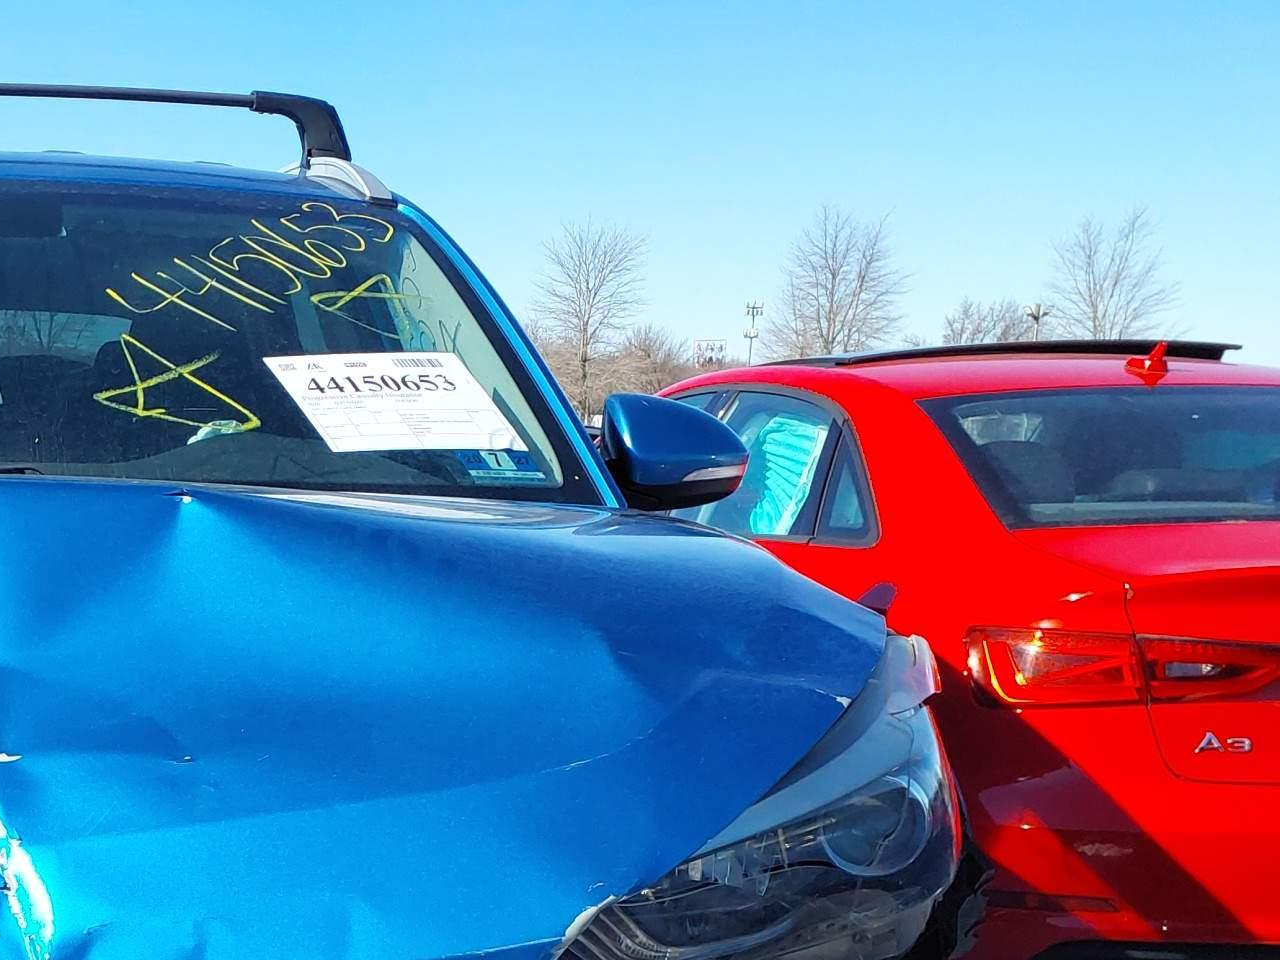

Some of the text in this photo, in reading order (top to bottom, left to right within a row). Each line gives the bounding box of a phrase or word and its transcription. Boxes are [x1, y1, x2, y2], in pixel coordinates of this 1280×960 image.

[307, 374, 457, 393] 44150653
[488, 452, 502, 467] 7
[1193, 731, 1253, 754] A3
